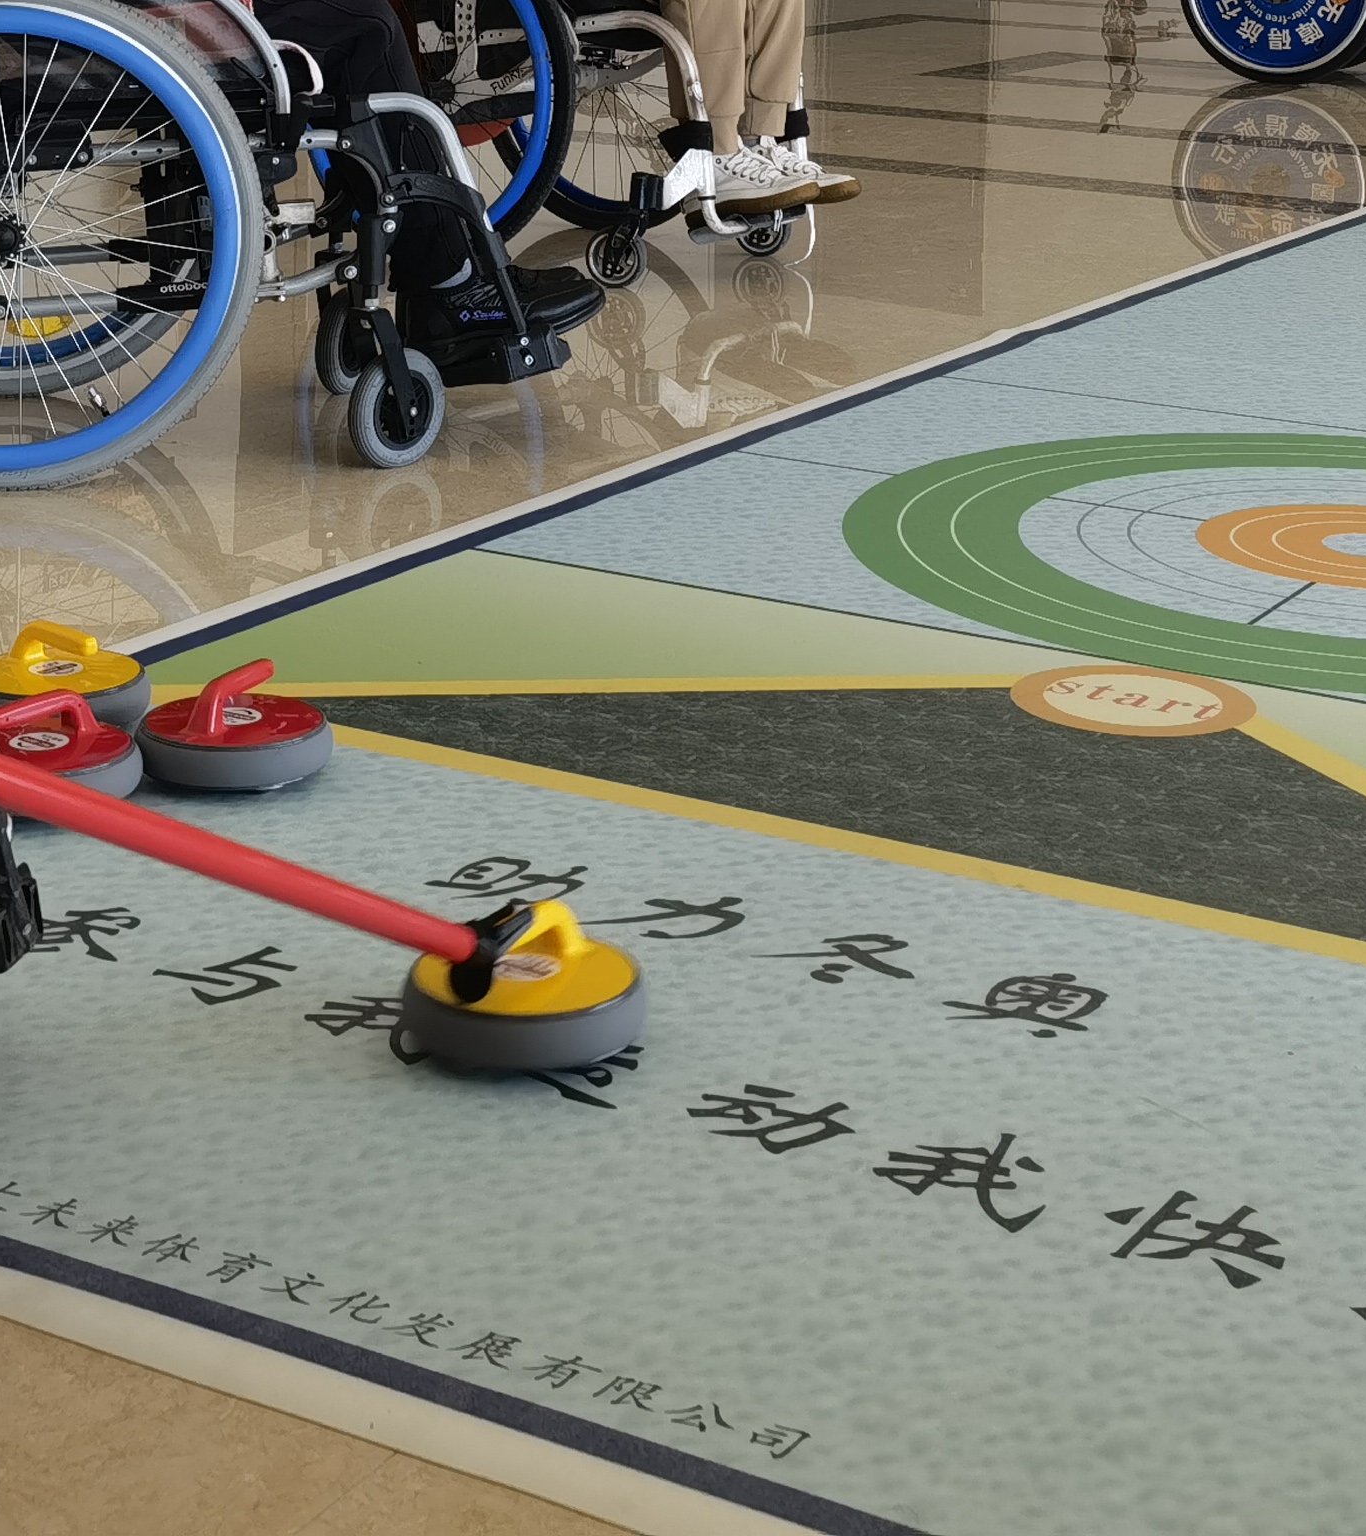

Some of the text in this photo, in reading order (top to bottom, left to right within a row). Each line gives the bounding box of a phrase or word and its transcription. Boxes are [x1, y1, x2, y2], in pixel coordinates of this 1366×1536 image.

[159, 282, 209, 294] ottoboc
[1046, 680, 1221, 720] start
[424, 855, 1111, 1039] 助力冬奥
